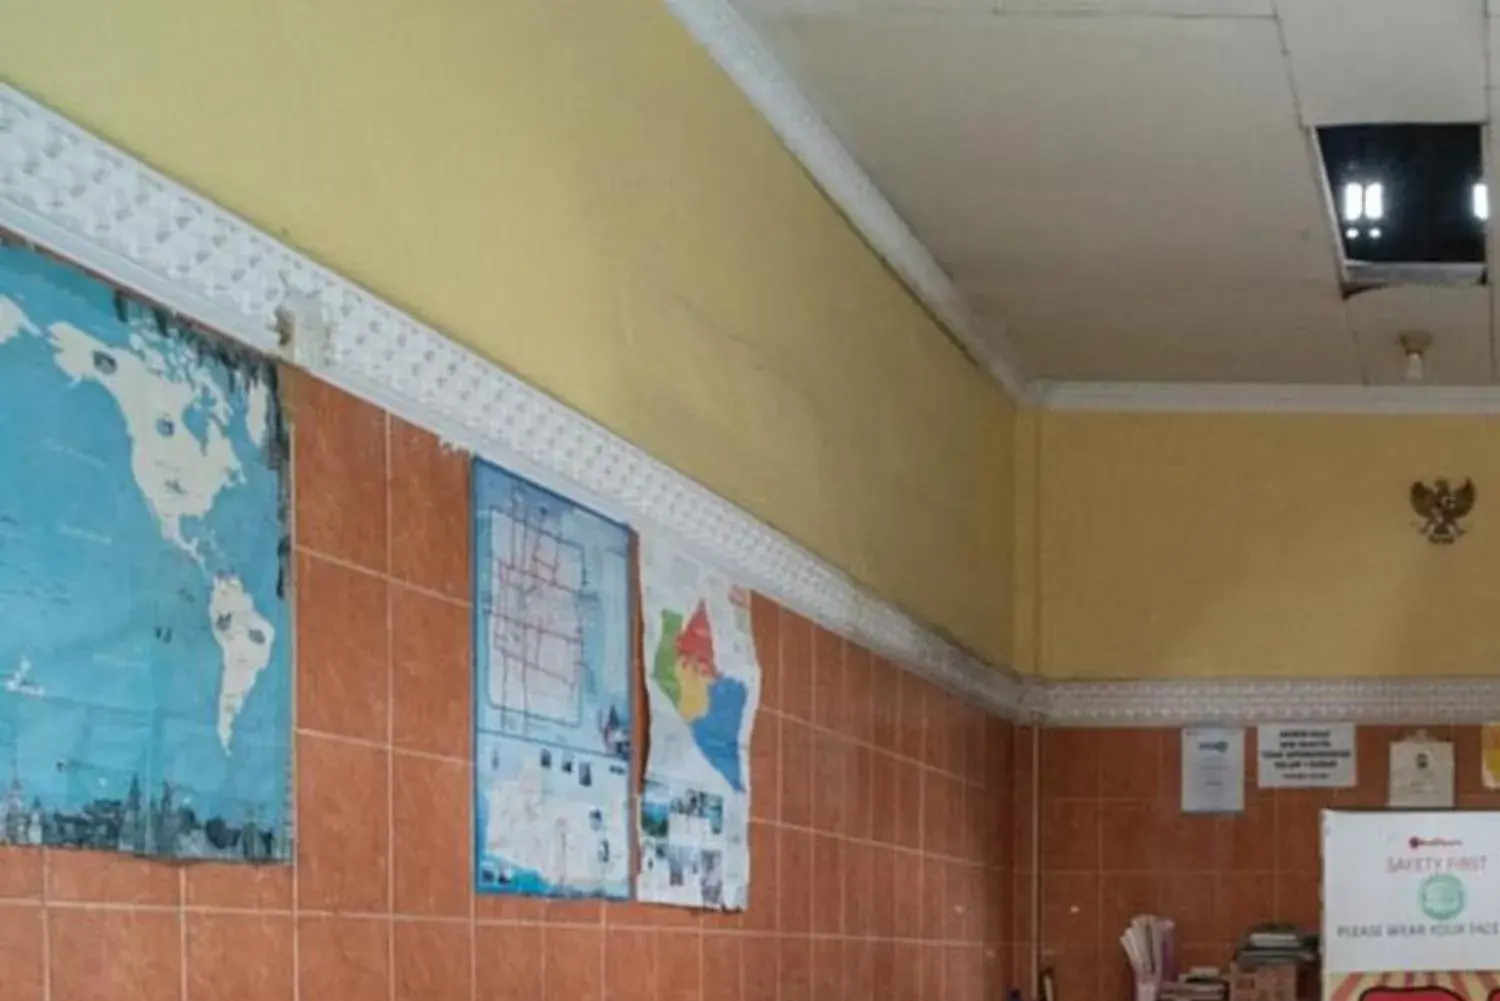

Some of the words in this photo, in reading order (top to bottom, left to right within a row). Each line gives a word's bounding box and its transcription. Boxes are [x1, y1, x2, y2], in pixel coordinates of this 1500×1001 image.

[1386, 855, 1442, 873] SAFETY
[1446, 855, 1488, 871] FIRST
[1336, 924, 1382, 937] PLEASE
[1386, 924, 1426, 936] WEAR
[1469, 922, 1499, 935] FACE
